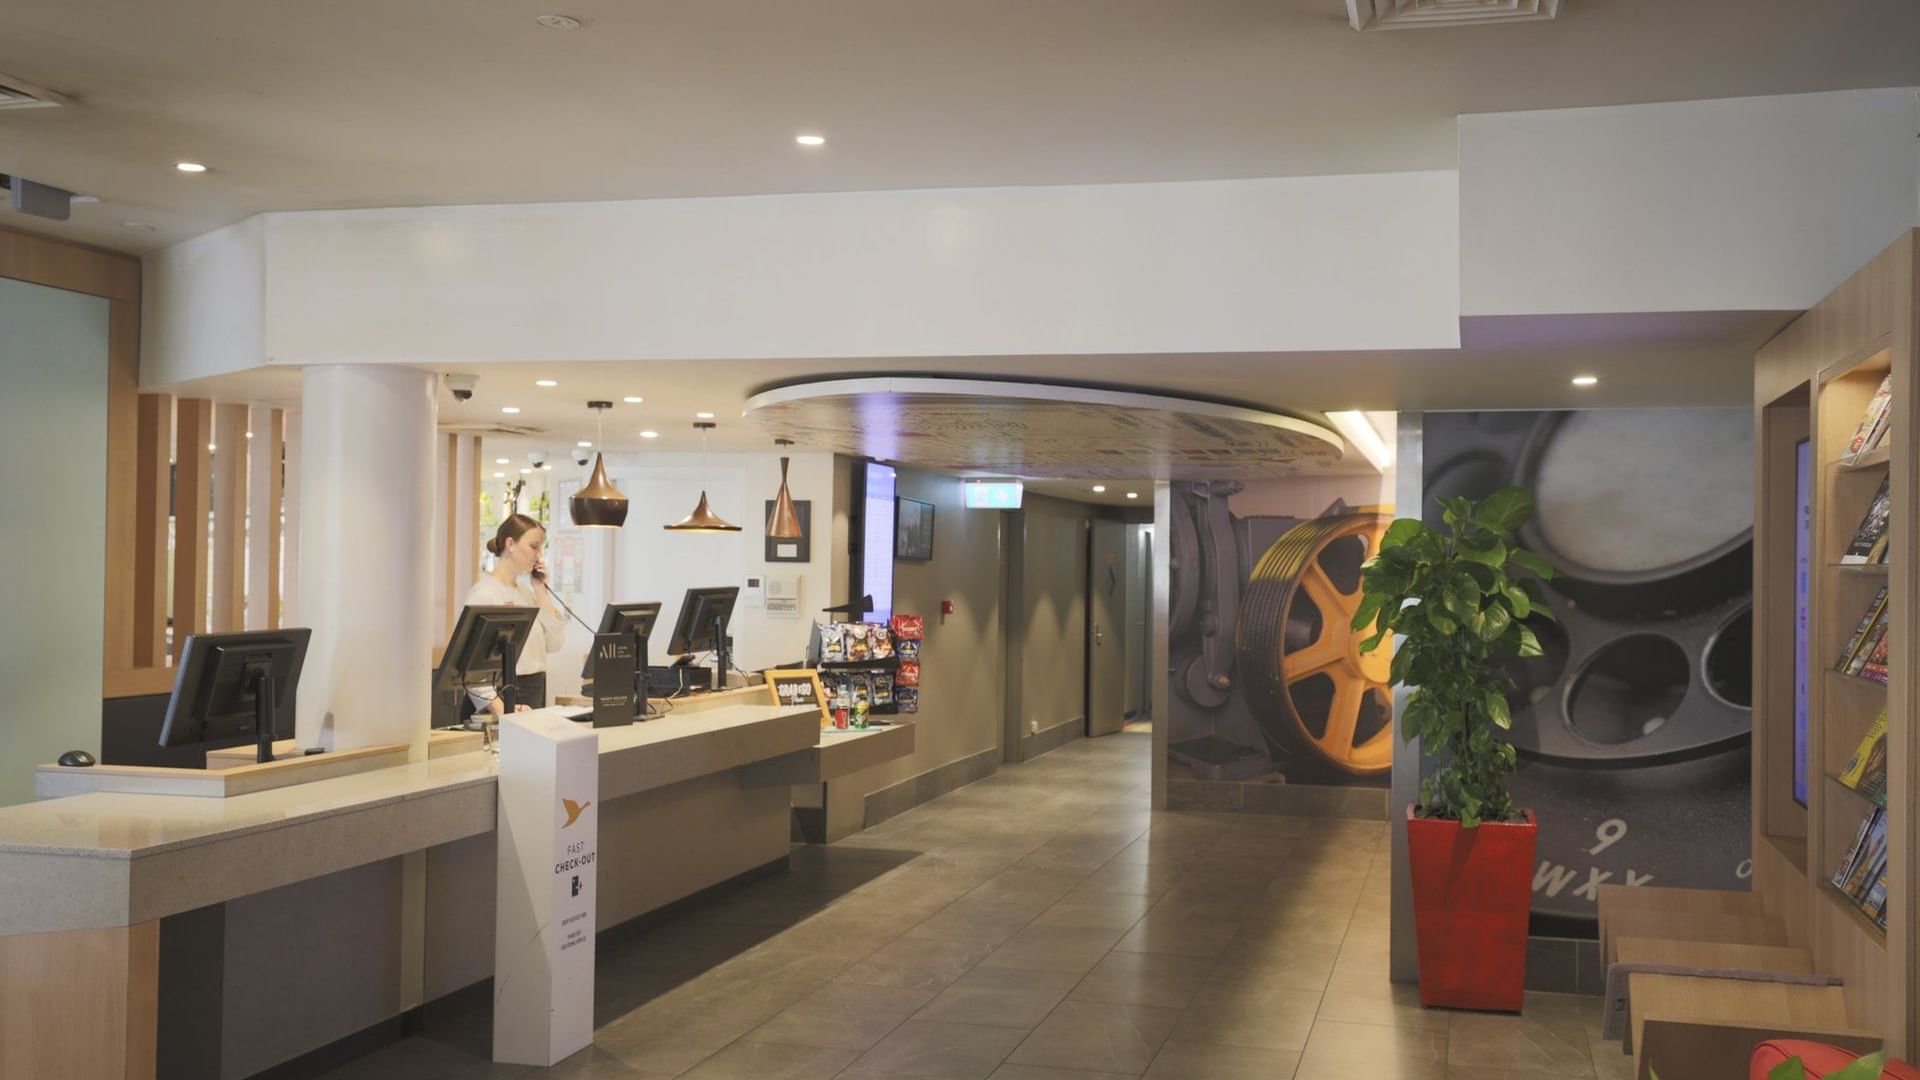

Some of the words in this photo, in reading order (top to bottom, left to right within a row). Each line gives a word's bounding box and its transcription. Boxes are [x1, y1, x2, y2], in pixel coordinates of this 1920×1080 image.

[567, 841, 585, 855] FAST
[1589, 818, 1628, 856] 9
[555, 852, 596, 874] CHECK-OUT
